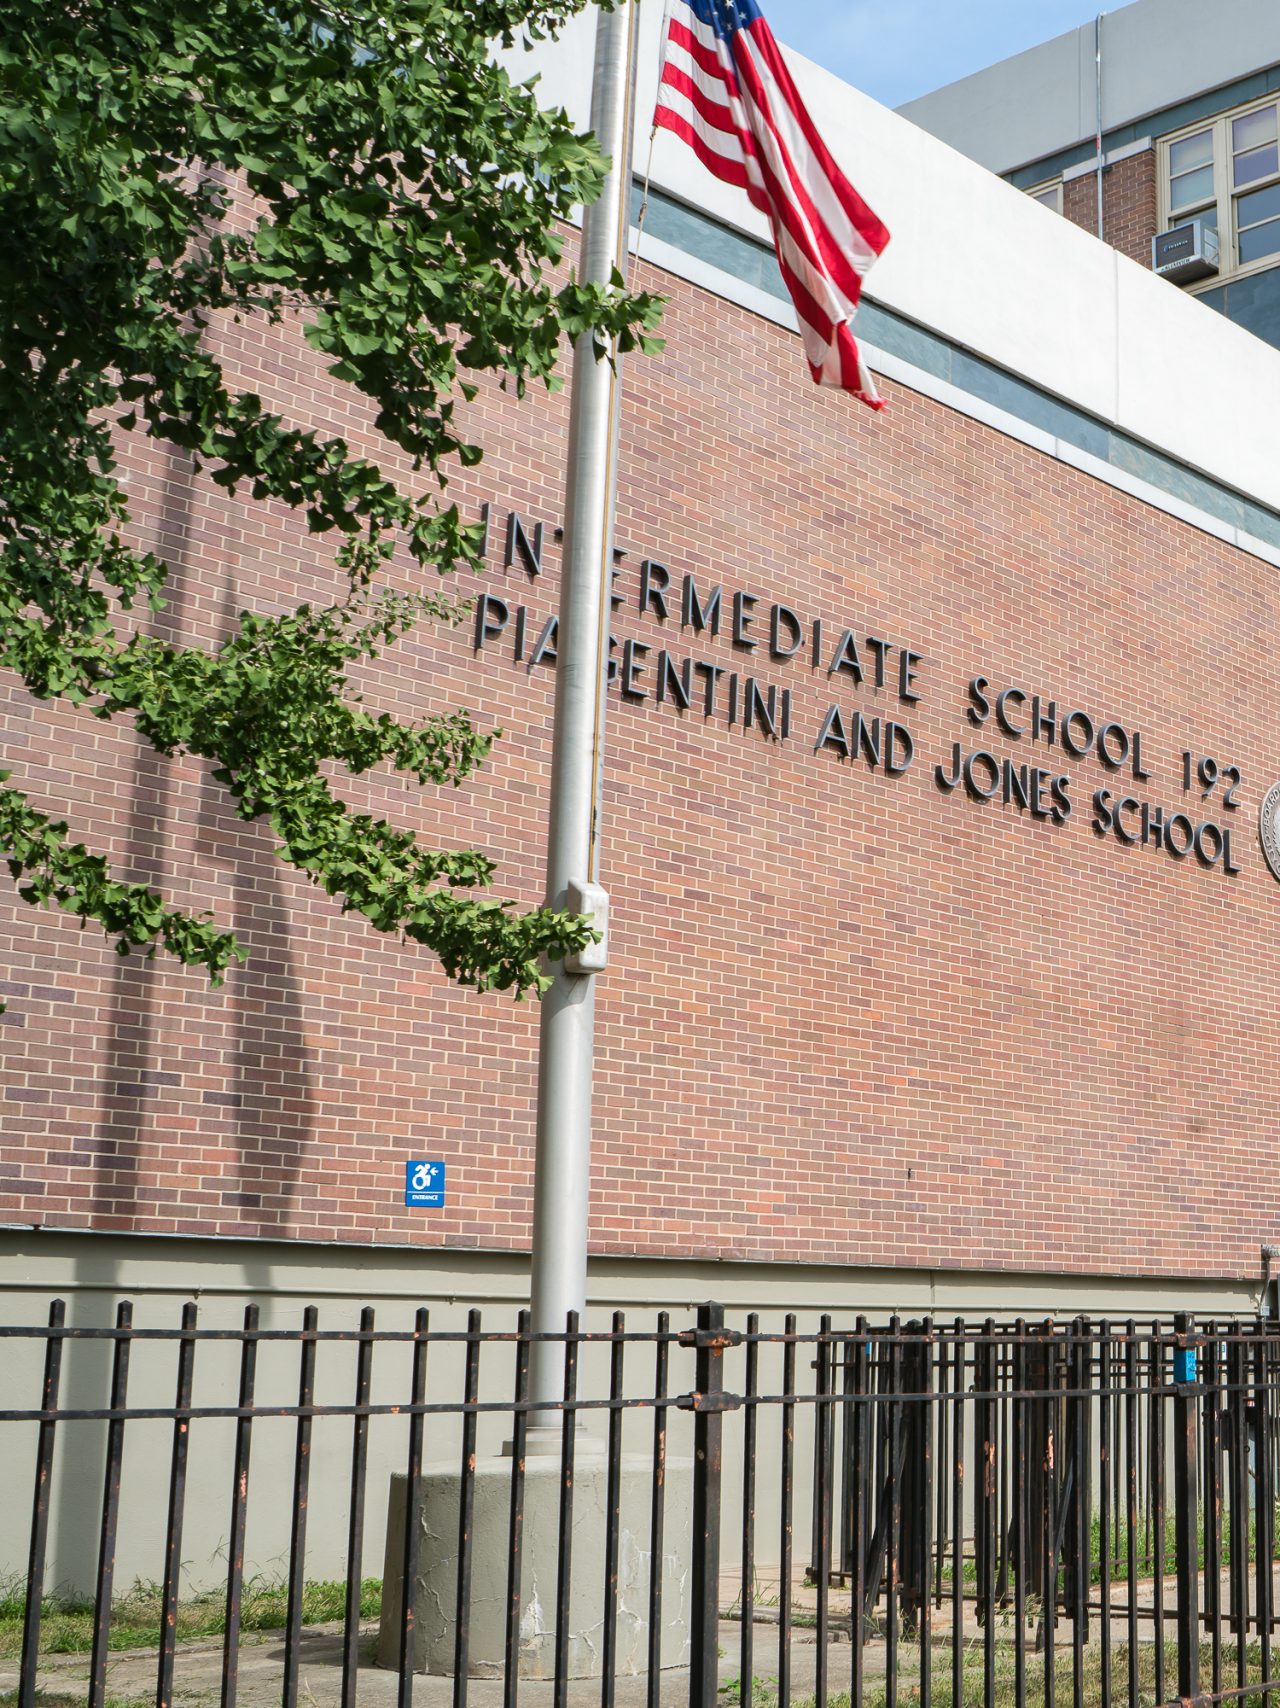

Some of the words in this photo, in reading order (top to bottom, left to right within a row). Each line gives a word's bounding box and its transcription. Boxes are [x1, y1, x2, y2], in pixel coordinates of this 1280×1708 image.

[478, 502, 924, 701] INERMEDIATE
[967, 676, 1152, 778] SCHOOL
[1182, 752, 1242, 808] 192
[814, 703, 914, 772] AND
[935, 743, 1072, 820] JONES
[1092, 789, 1242, 874] SCHOOL
[1263, 789, 1280, 827] BOARD
